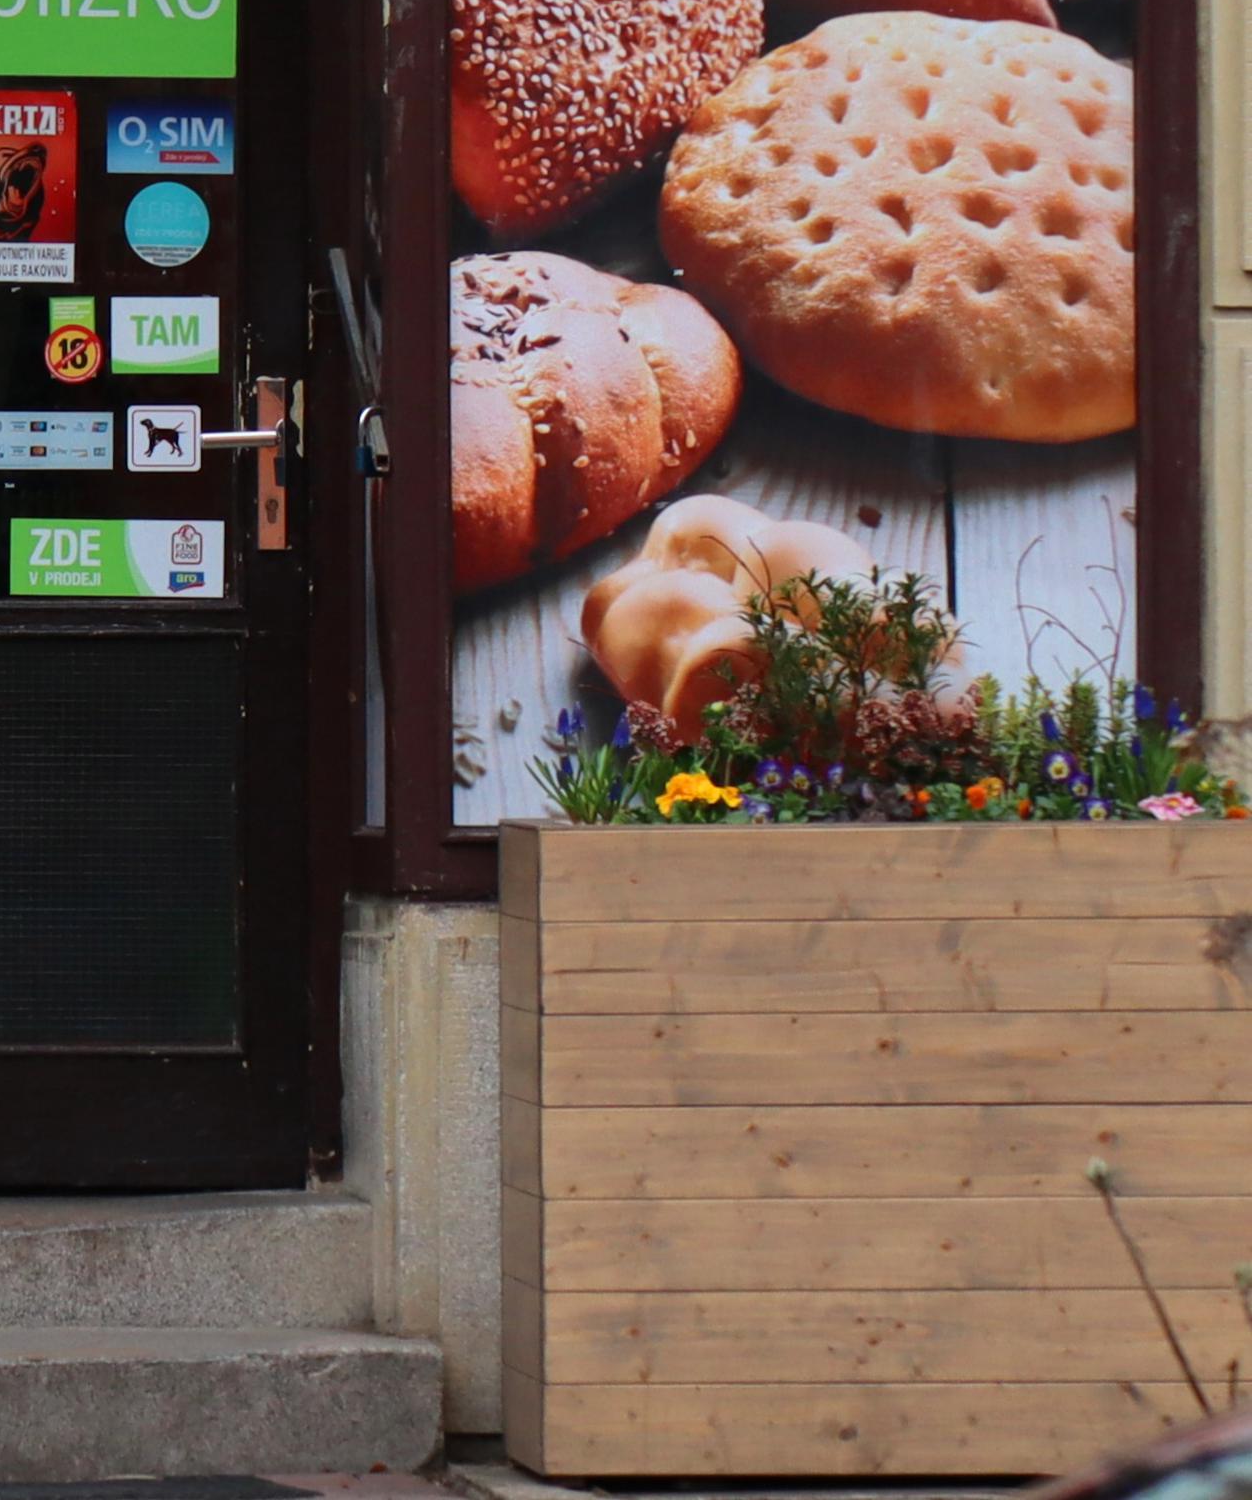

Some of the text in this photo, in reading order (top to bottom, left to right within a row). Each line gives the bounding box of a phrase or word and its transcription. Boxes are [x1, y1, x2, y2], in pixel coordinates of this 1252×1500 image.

[158, 116, 225, 147] SIM
[20, 264, 68, 278] RAKOVINU
[129, 315, 200, 346] TAM
[58, 338, 89, 370] 18
[29, 527, 101, 567] ZDE
[29, 571, 102, 587] V PRODEJI
[176, 573, 198, 584] aro
